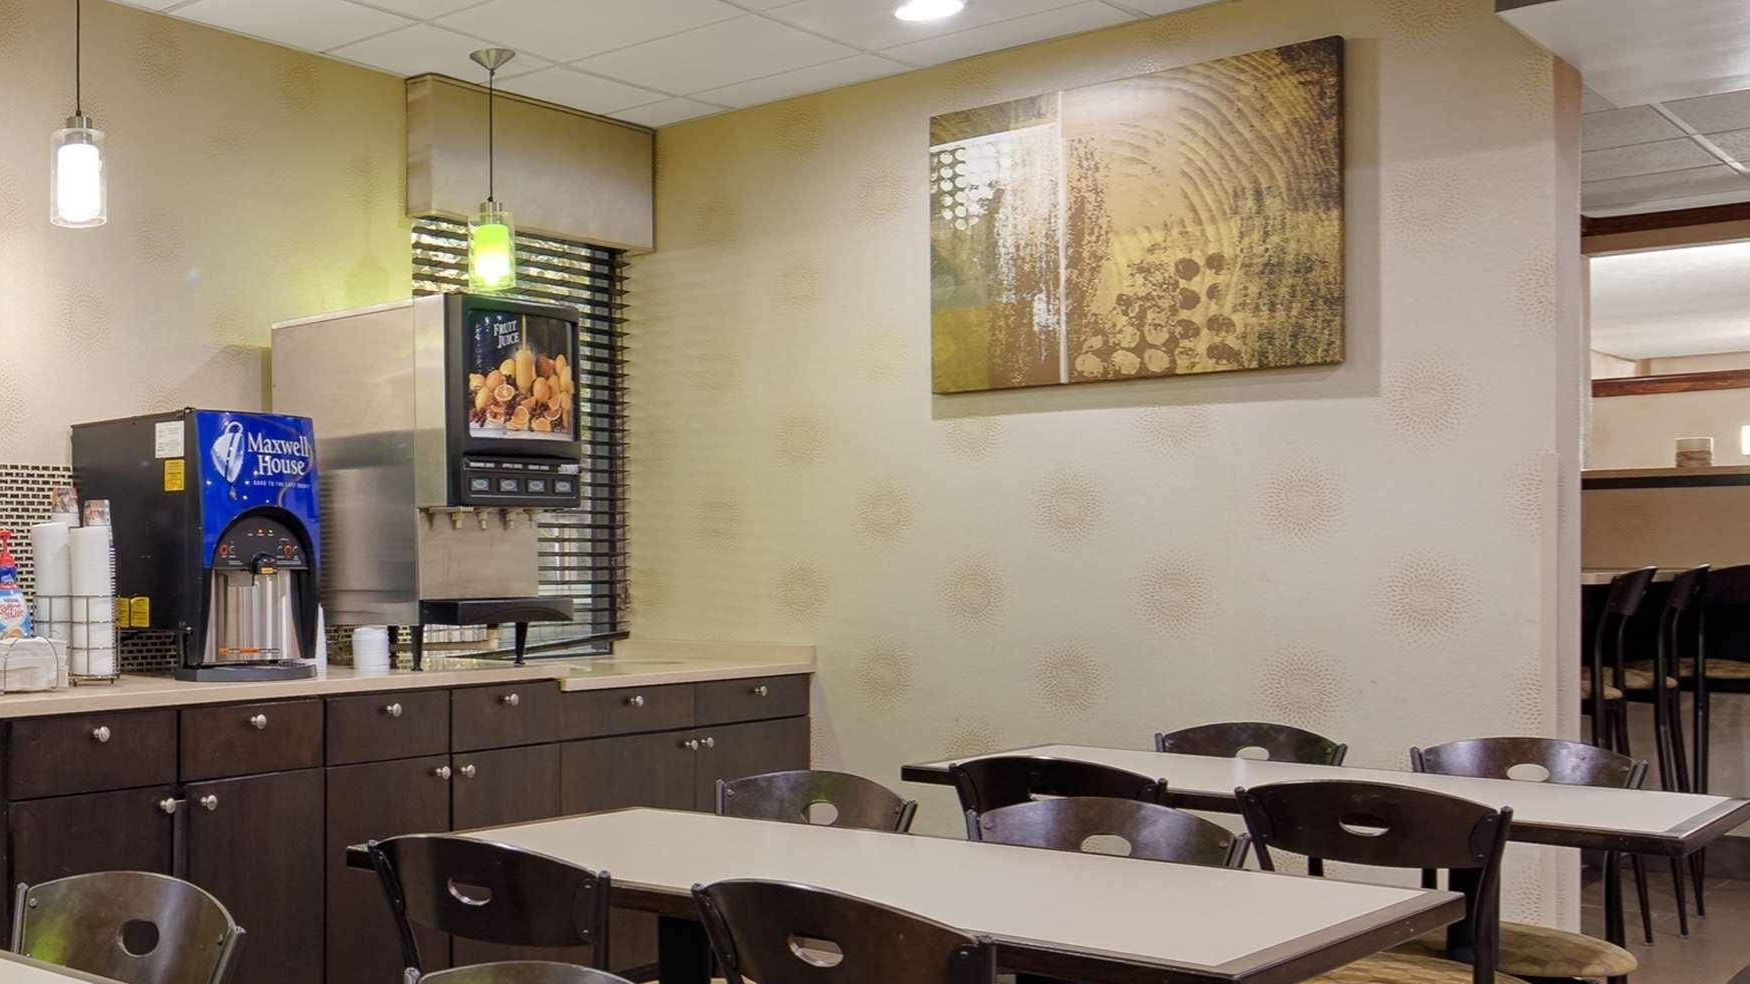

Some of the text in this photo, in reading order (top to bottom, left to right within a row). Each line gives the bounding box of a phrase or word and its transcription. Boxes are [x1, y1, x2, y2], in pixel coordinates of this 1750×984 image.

[493, 320, 518, 337] FRUIT
[497, 332, 520, 349] JUICE
[247, 431, 310, 457] Maxwell
[258, 455, 306, 476] House
